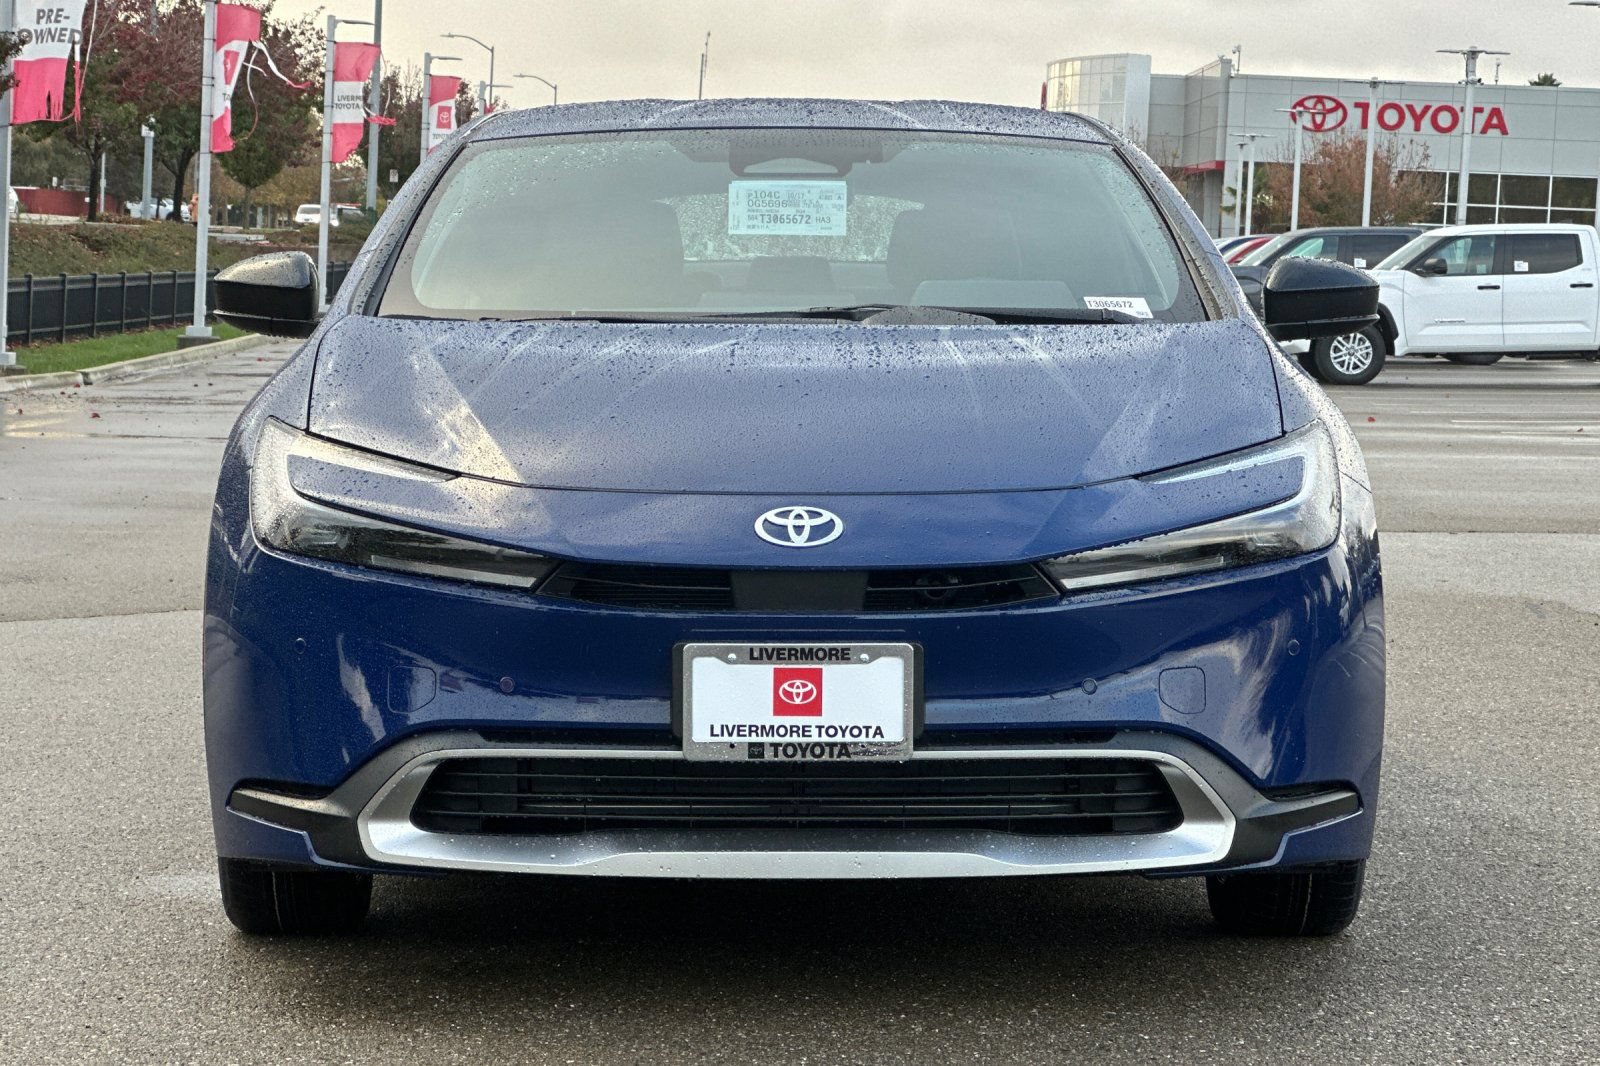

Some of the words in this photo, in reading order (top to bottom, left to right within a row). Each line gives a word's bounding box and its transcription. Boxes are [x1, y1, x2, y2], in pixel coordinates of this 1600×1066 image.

[36, 8, 70, 25] PRE-
[18, 27, 83, 45] OWNED
[760, 214, 811, 224] T3065672
[1087, 300, 1133, 308] T3065672
[749, 647, 851, 661] LIVERMORE
[710, 724, 812, 738] LIVERMORE
[817, 725, 885, 739] TOYOTA
[769, 743, 852, 759] TOYOTA
